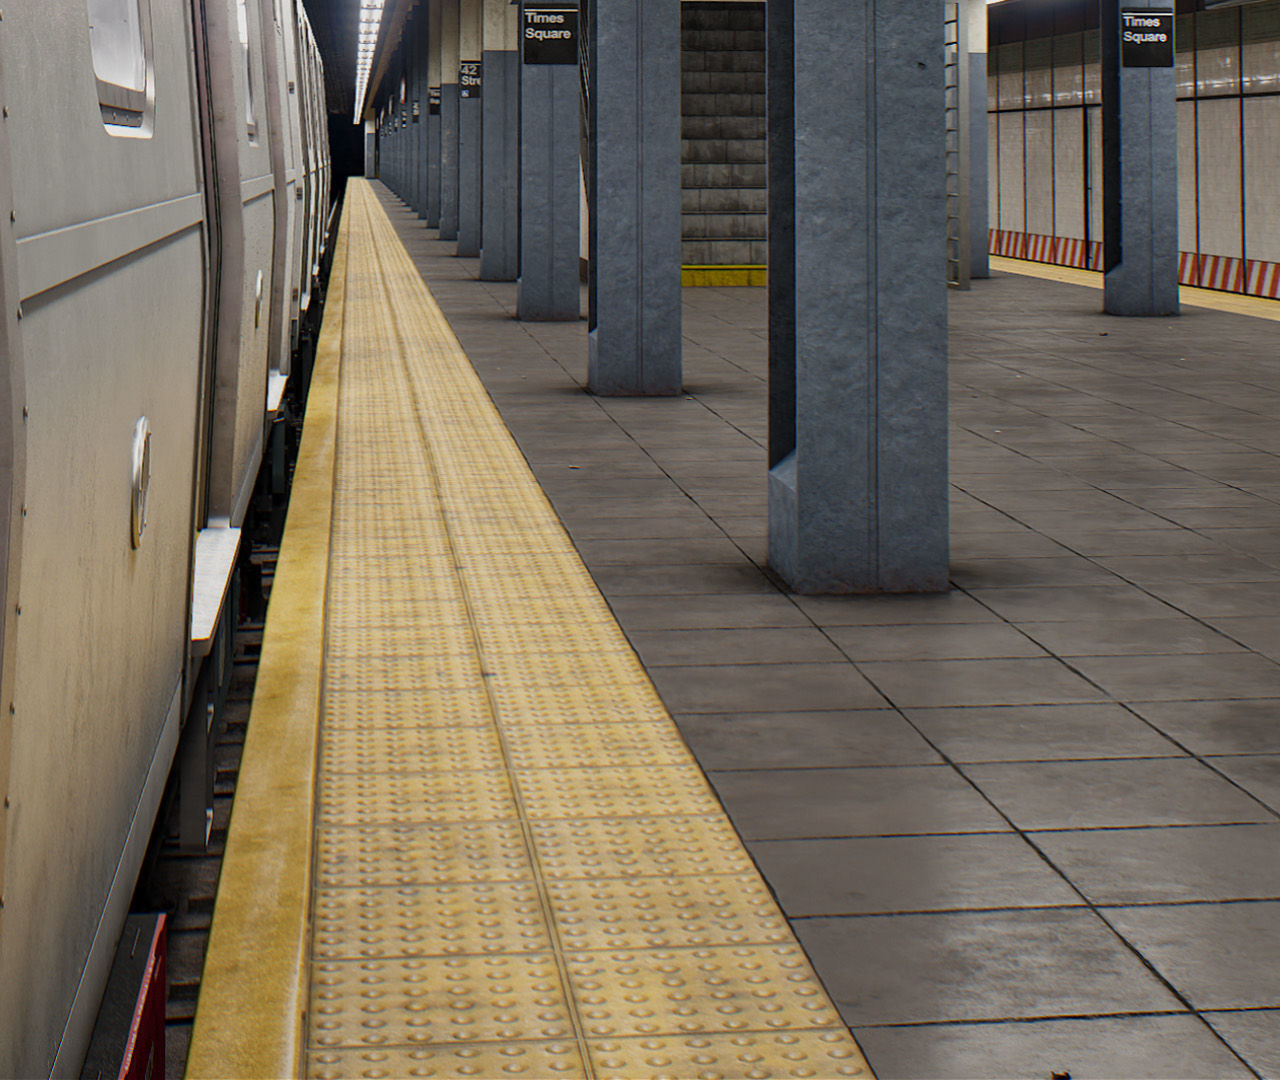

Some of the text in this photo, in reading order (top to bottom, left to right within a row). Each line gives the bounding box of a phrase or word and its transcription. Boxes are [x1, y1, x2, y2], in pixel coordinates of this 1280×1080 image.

[524, 12, 565, 24] Times
[1122, 16, 1161, 27] Times
[524, 27, 572, 41] Square
[1122, 31, 1168, 44] Square
